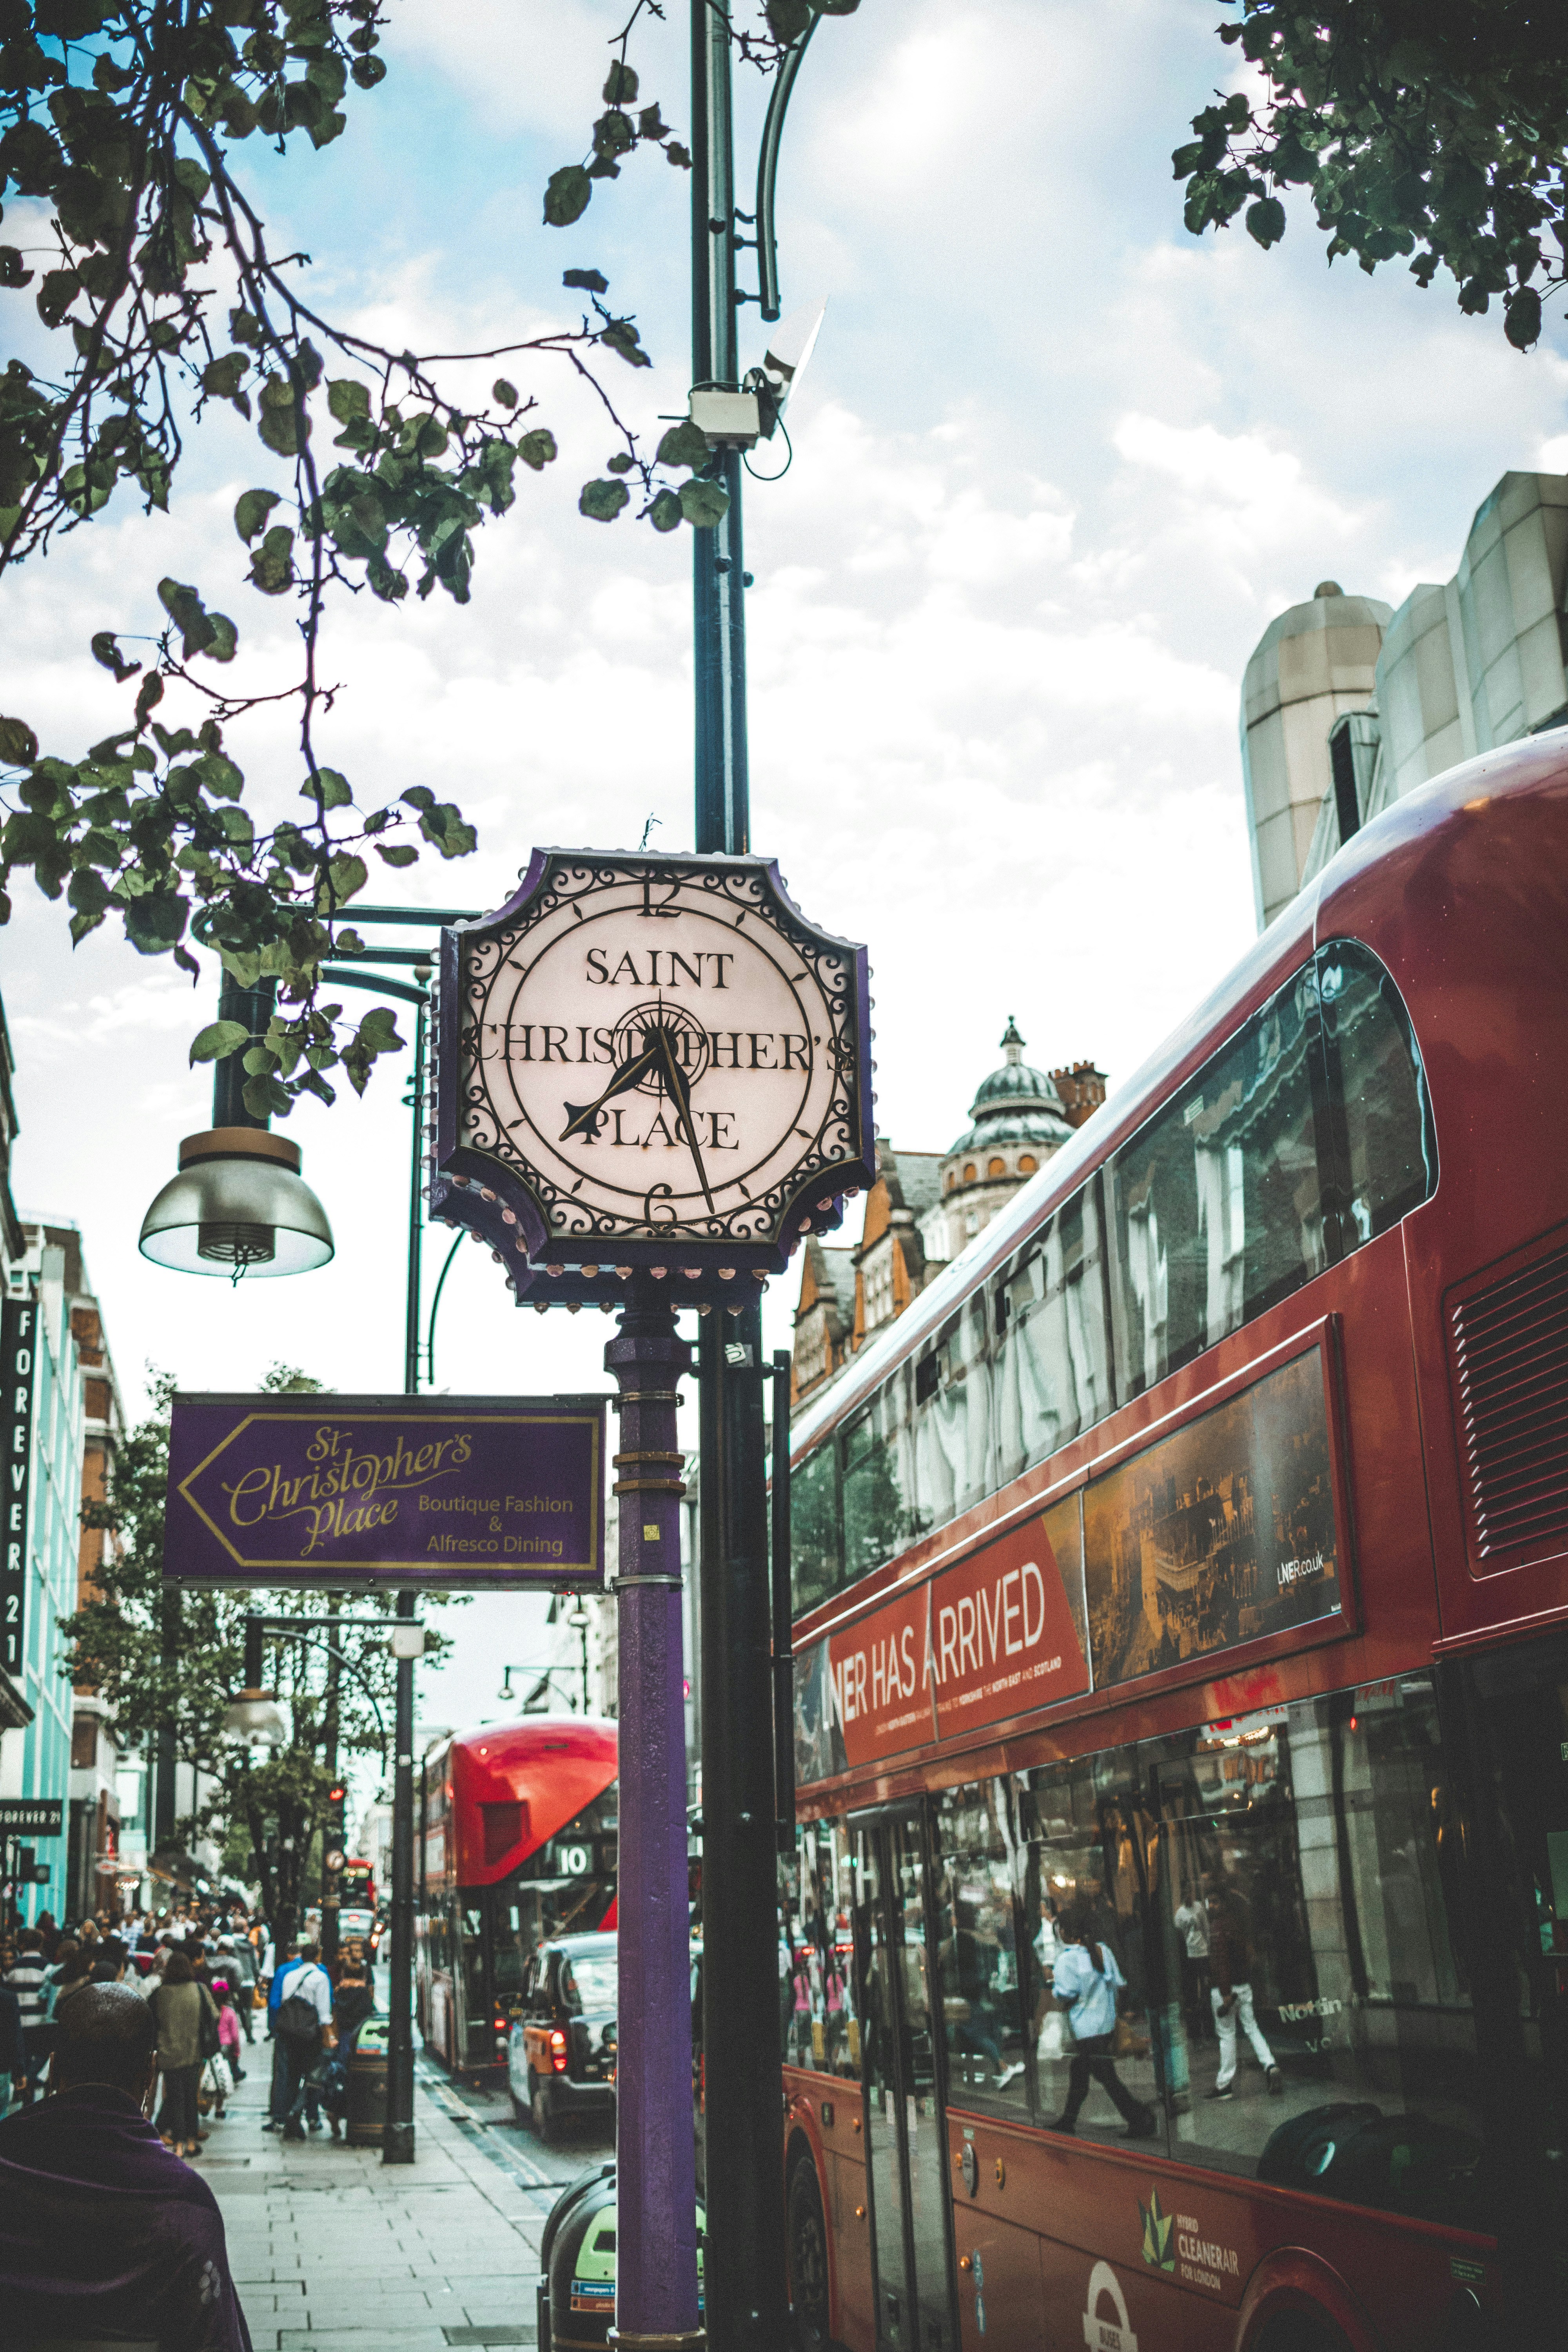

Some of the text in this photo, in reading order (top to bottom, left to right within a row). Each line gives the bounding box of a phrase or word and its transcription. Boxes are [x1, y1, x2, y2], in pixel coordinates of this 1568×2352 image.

[637, 865, 682, 918] 12
[586, 948, 734, 989] SAINT
[644, 1183, 677, 1236] 6
[307, 1426, 352, 1461] St
[5, 1310, 31, 1662] FOREVER 21
[221, 1434, 472, 1526] Christopher's
[419, 1494, 573, 1516] Boutique Fashion
[489, 1515, 503, 1532] &
[267, 1498, 398, 1556] Place
[426, 1534, 563, 1557] Alfresco Dining
[1277, 1550, 1324, 1585] LNER.co.uk
[872, 1625, 916, 1710] HAS
[922, 1562, 1045, 1690] ARRIVED
[561, 1846, 587, 1874] 10
